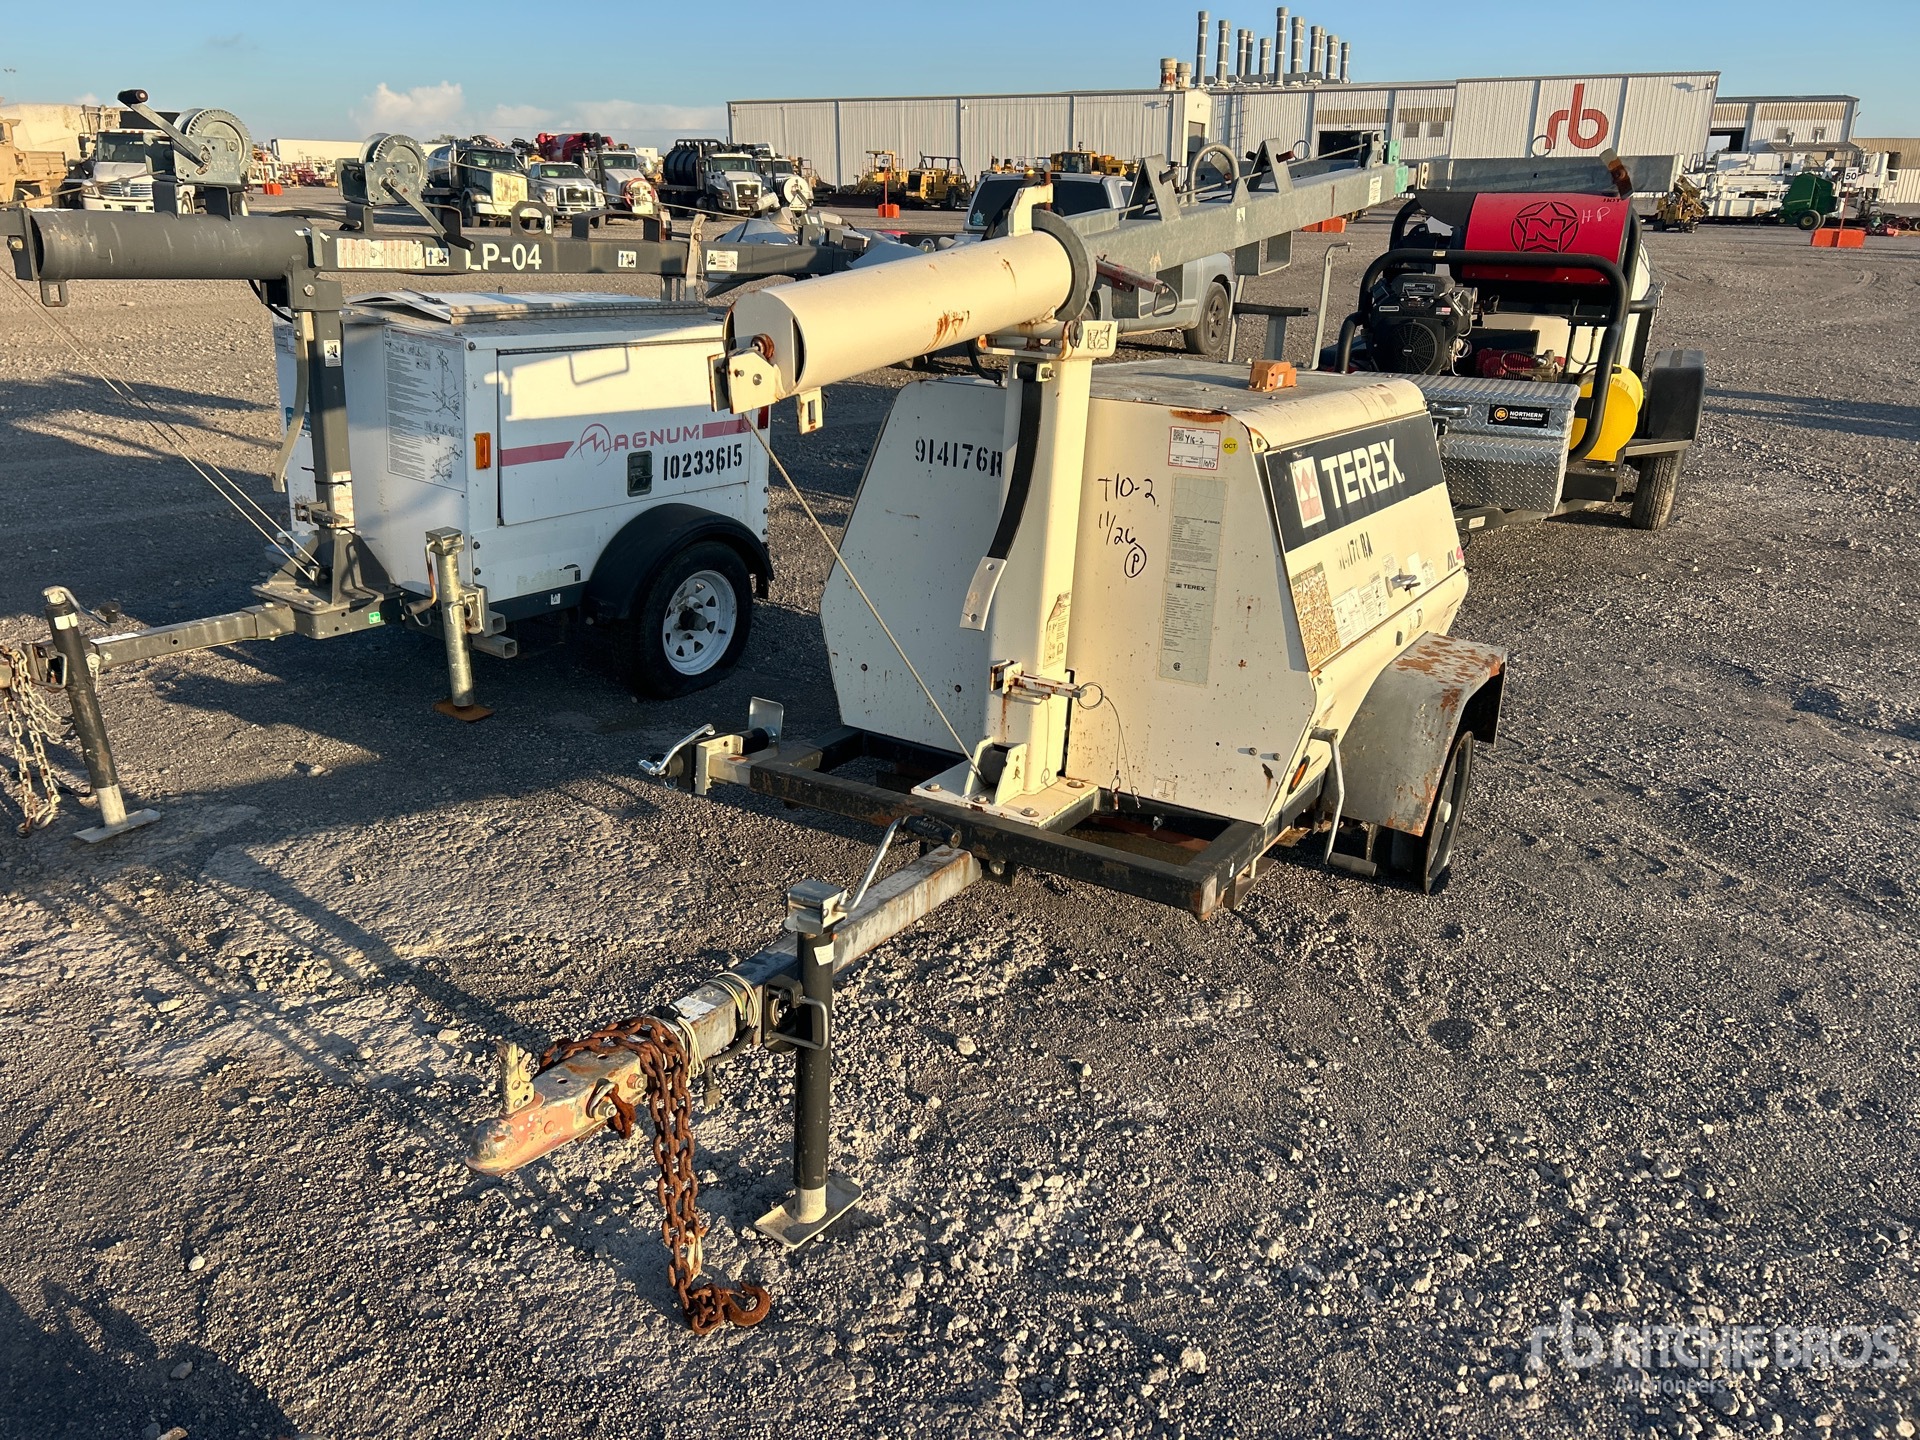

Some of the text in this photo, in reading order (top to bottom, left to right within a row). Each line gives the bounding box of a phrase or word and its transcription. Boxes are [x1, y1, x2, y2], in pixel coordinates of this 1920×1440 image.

[1545, 83, 1609, 149] rb
[1845, 172, 1857, 180] 50
[465, 243, 542, 270] LP-04
[664, 443, 742, 481] 10233615
[1321, 439, 1404, 508] TEREX
[1183, 583, 1206, 591] TEREX
